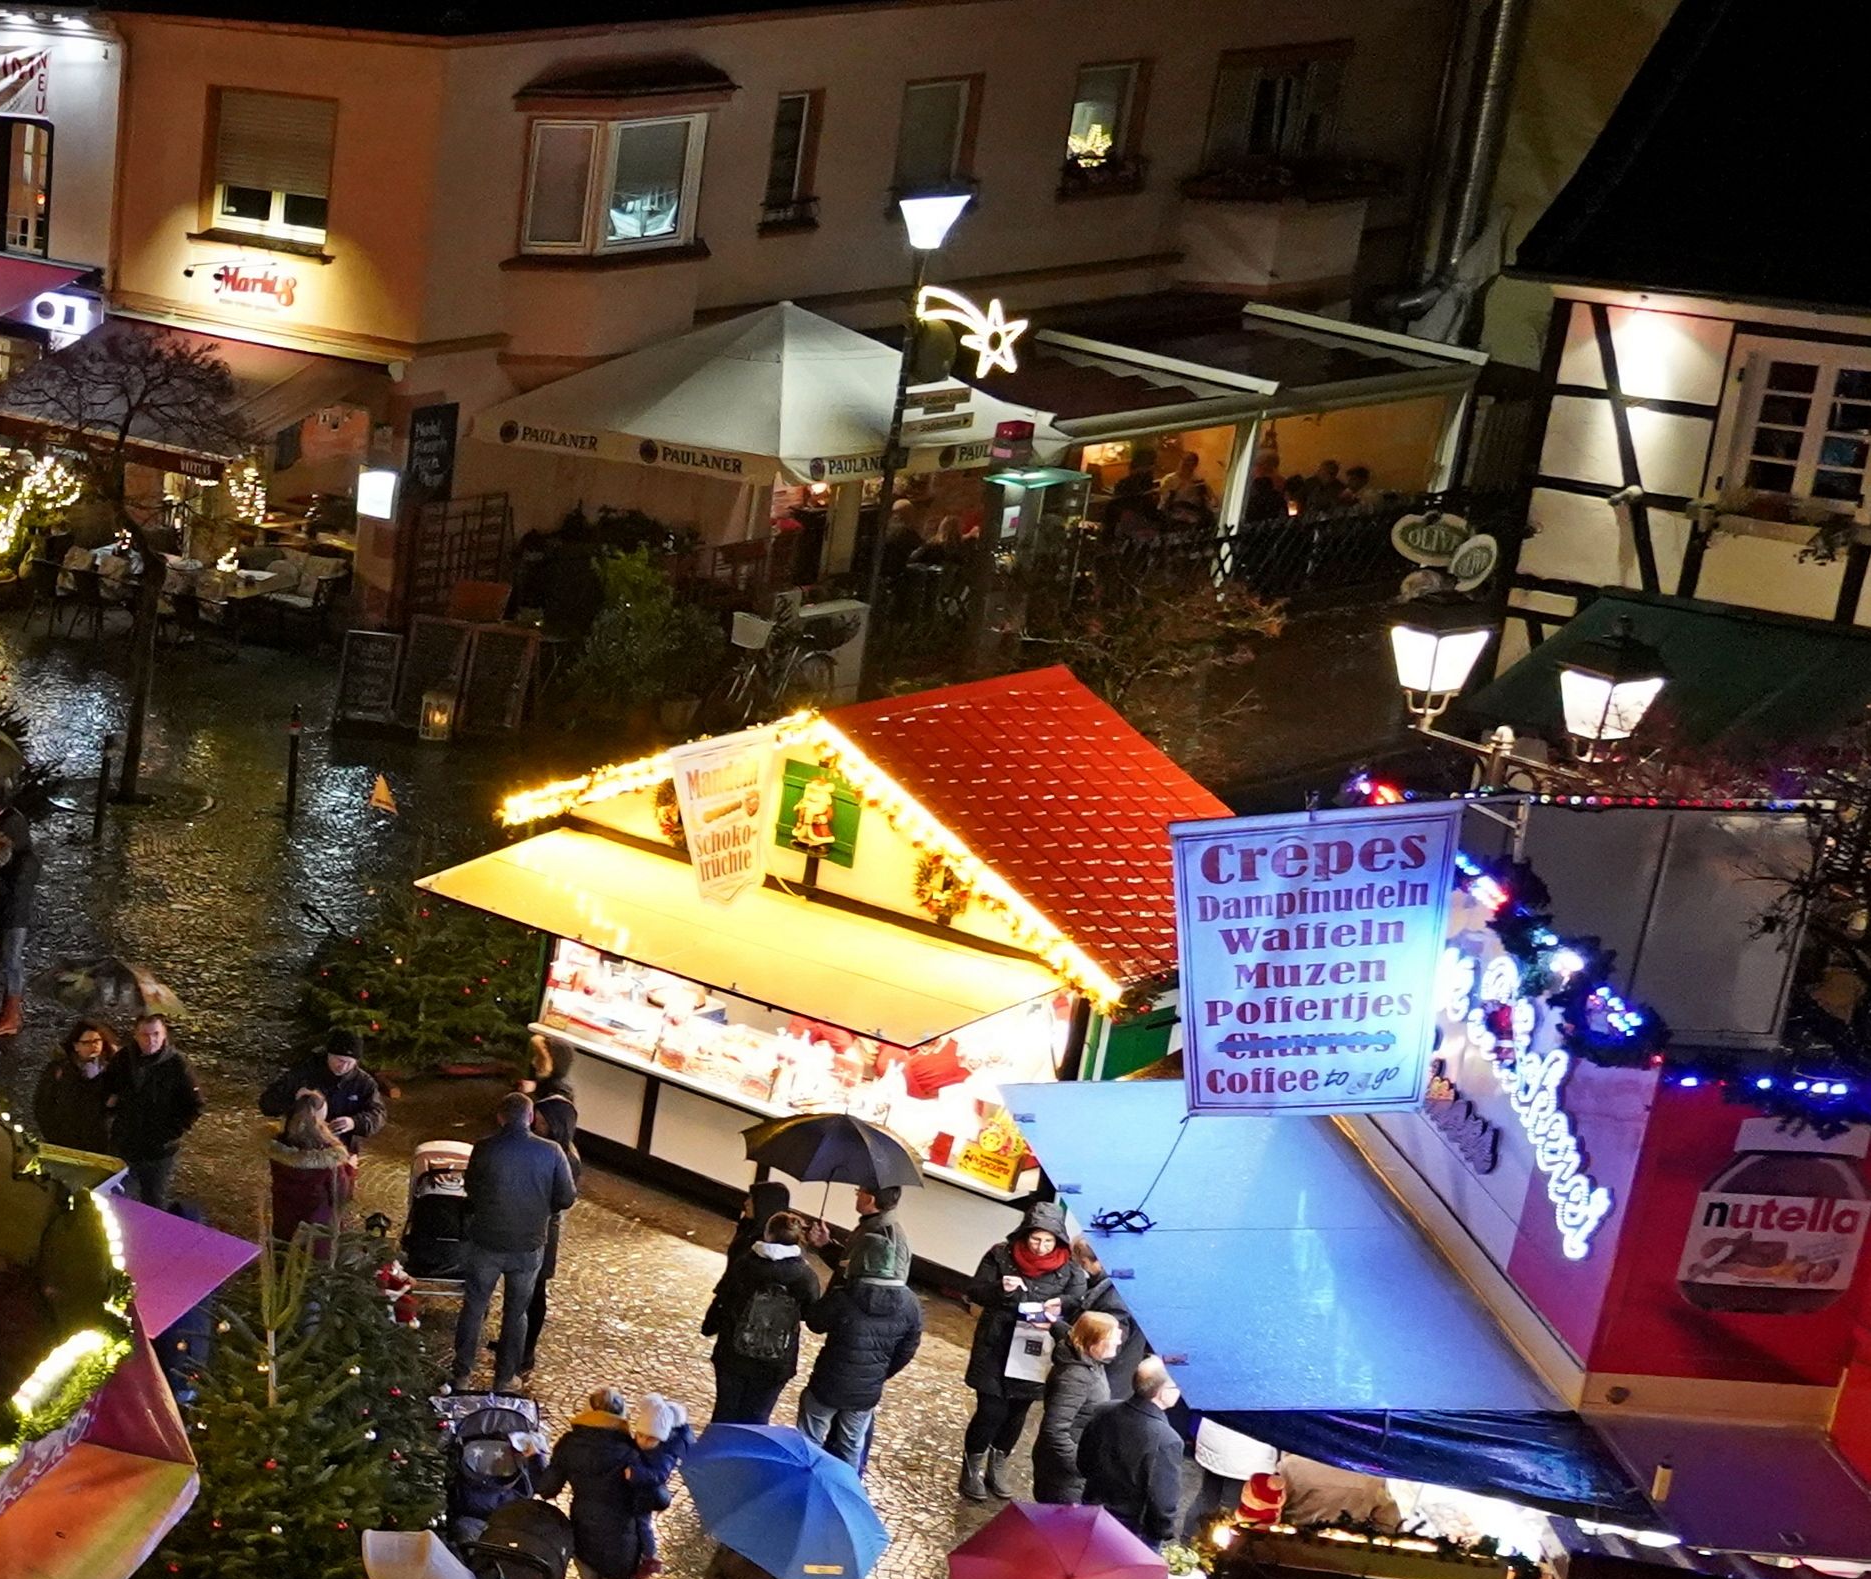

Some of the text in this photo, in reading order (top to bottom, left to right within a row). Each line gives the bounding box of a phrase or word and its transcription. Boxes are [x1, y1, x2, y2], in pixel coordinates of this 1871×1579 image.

[35, 55, 48, 114] NEU
[521, 426, 598, 451] PAULANER
[662, 446, 743, 473] PAULANER
[694, 824, 758, 858] Schoko-
[1200, 834, 1428, 885] Crêpes
[1197, 880, 1429, 922] Dampfnudeln
[1218, 919, 1405, 955] Waffeln
[1234, 959, 1386, 991] Muzen
[1204, 992, 1413, 1027] Poffertjes
[1207, 1065, 1400, 1095] Coffee to go
[1703, 1198, 1861, 1234] nutella
